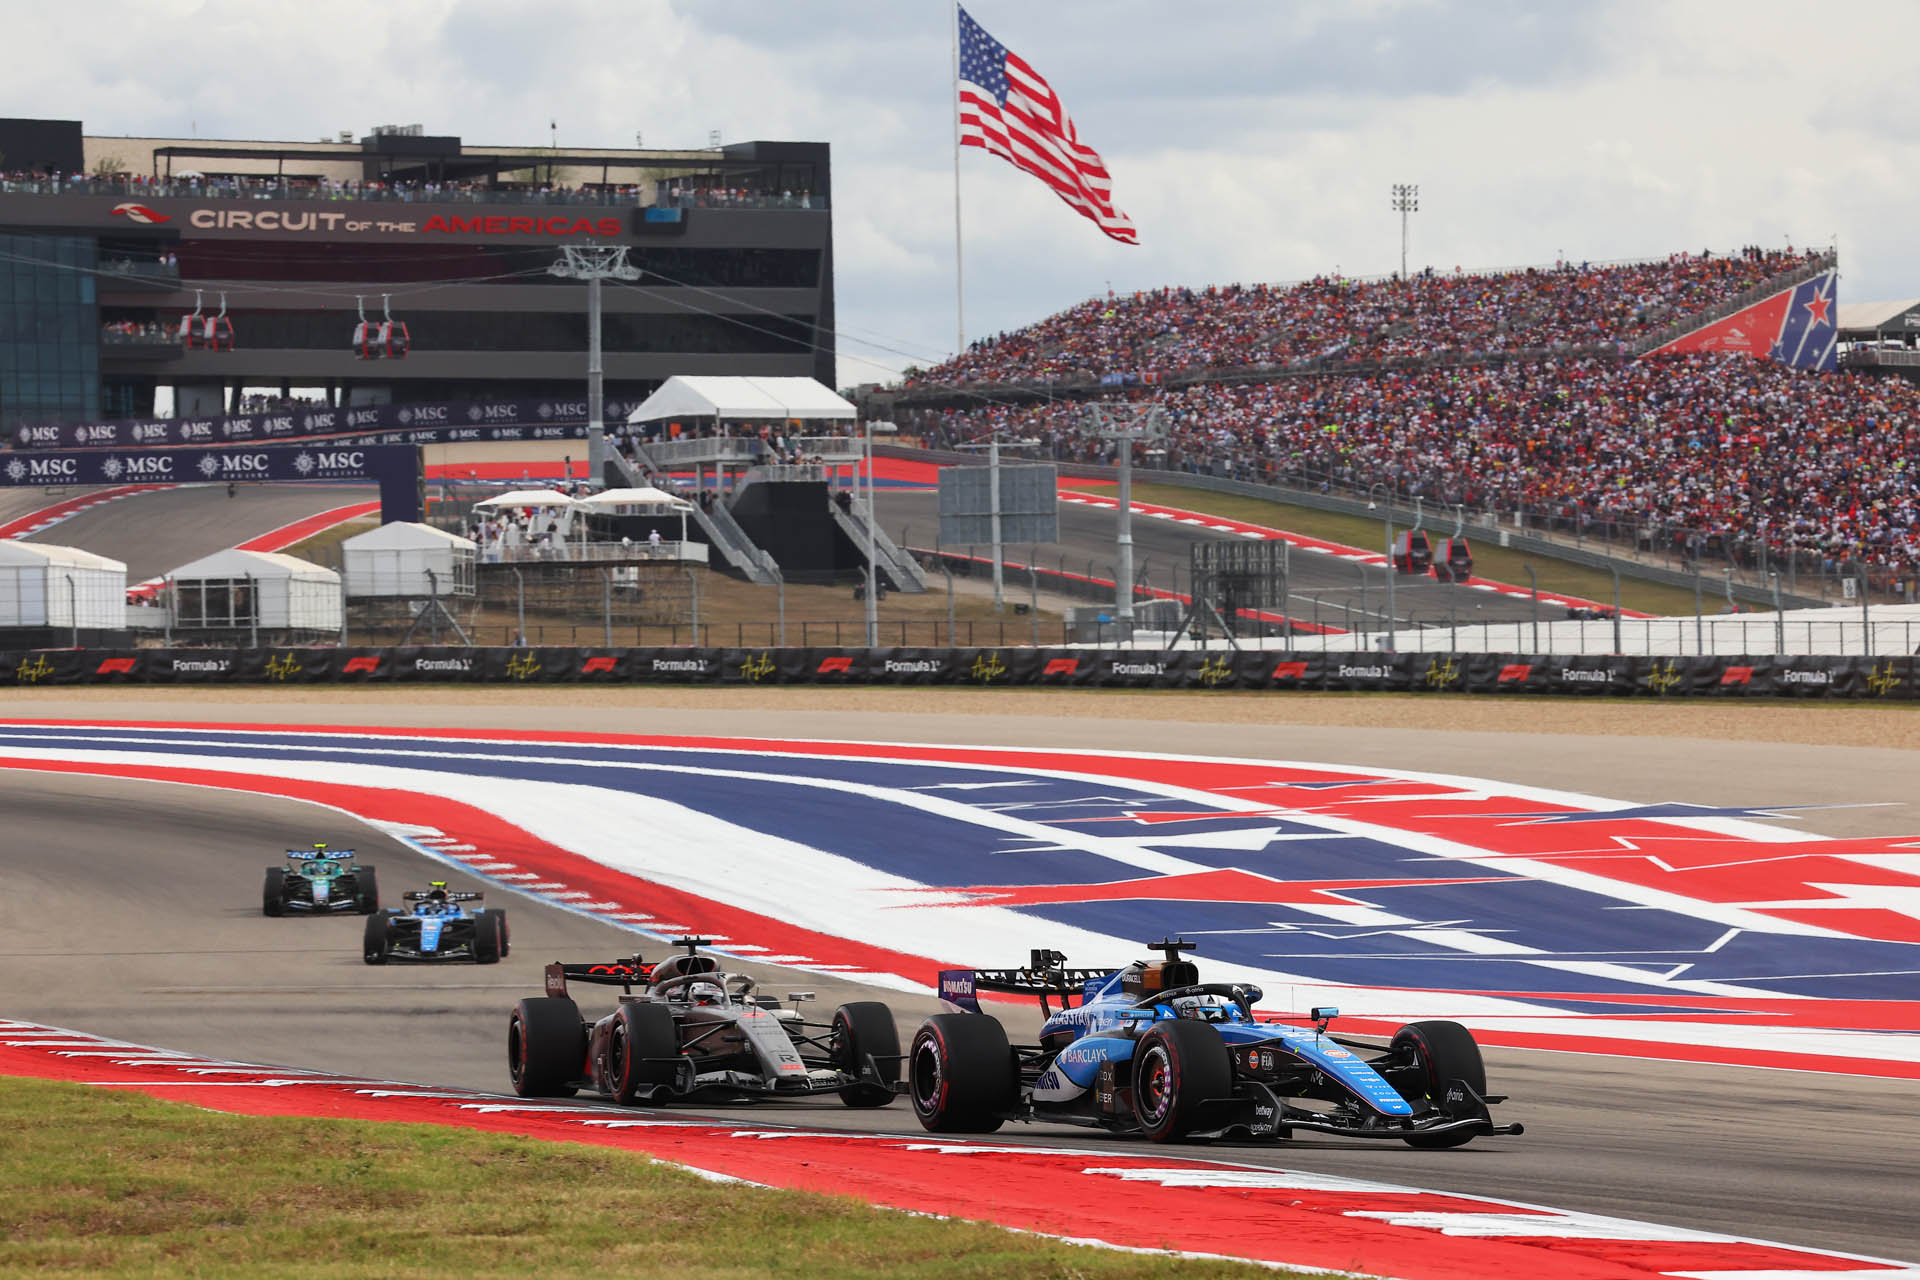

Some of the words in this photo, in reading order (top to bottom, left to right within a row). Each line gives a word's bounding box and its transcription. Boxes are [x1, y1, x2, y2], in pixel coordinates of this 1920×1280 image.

[190, 209, 345, 232] CIRCUIT
[345, 220, 371, 232] OF
[374, 220, 417, 233] THE
[421, 215, 622, 236] AMERICAS
[414, 406, 448, 420] MSC
[485, 405, 518, 418] MSC
[555, 403, 587, 416] MSC
[273, 416, 293, 431] MSC
[314, 413, 335, 428] MSC
[357, 410, 378, 424] MSC
[89, 425, 116, 440] MSC
[144, 424, 168, 437] MSC
[192, 422, 213, 436] MSC
[232, 419, 252, 433] MSC
[502, 428, 523, 437] MSC
[543, 427, 564, 436] MSC
[32, 427, 59, 441] MSC
[416, 431, 437, 441] MSC
[459, 429, 480, 439] MSC
[30, 458, 77, 476] MSC
[126, 456, 173, 473] MSC
[222, 453, 269, 471] MSC
[318, 451, 365, 469] MSC
[173, 659, 217, 671] Formula
[416, 658, 462, 670] Formula
[653, 659, 696, 671] Formula
[885, 660, 929, 672] Formula
[1112, 662, 1156, 674] Formula
[1339, 665, 1382, 677] Formula
[1562, 668, 1605, 681] Formula
[1783, 669, 1827, 683] Formula
[1068, 1048, 1107, 1063] BARCLAYS
[1261, 1055, 1273, 1067] FIA
[1255, 1104, 1274, 1119] betway
